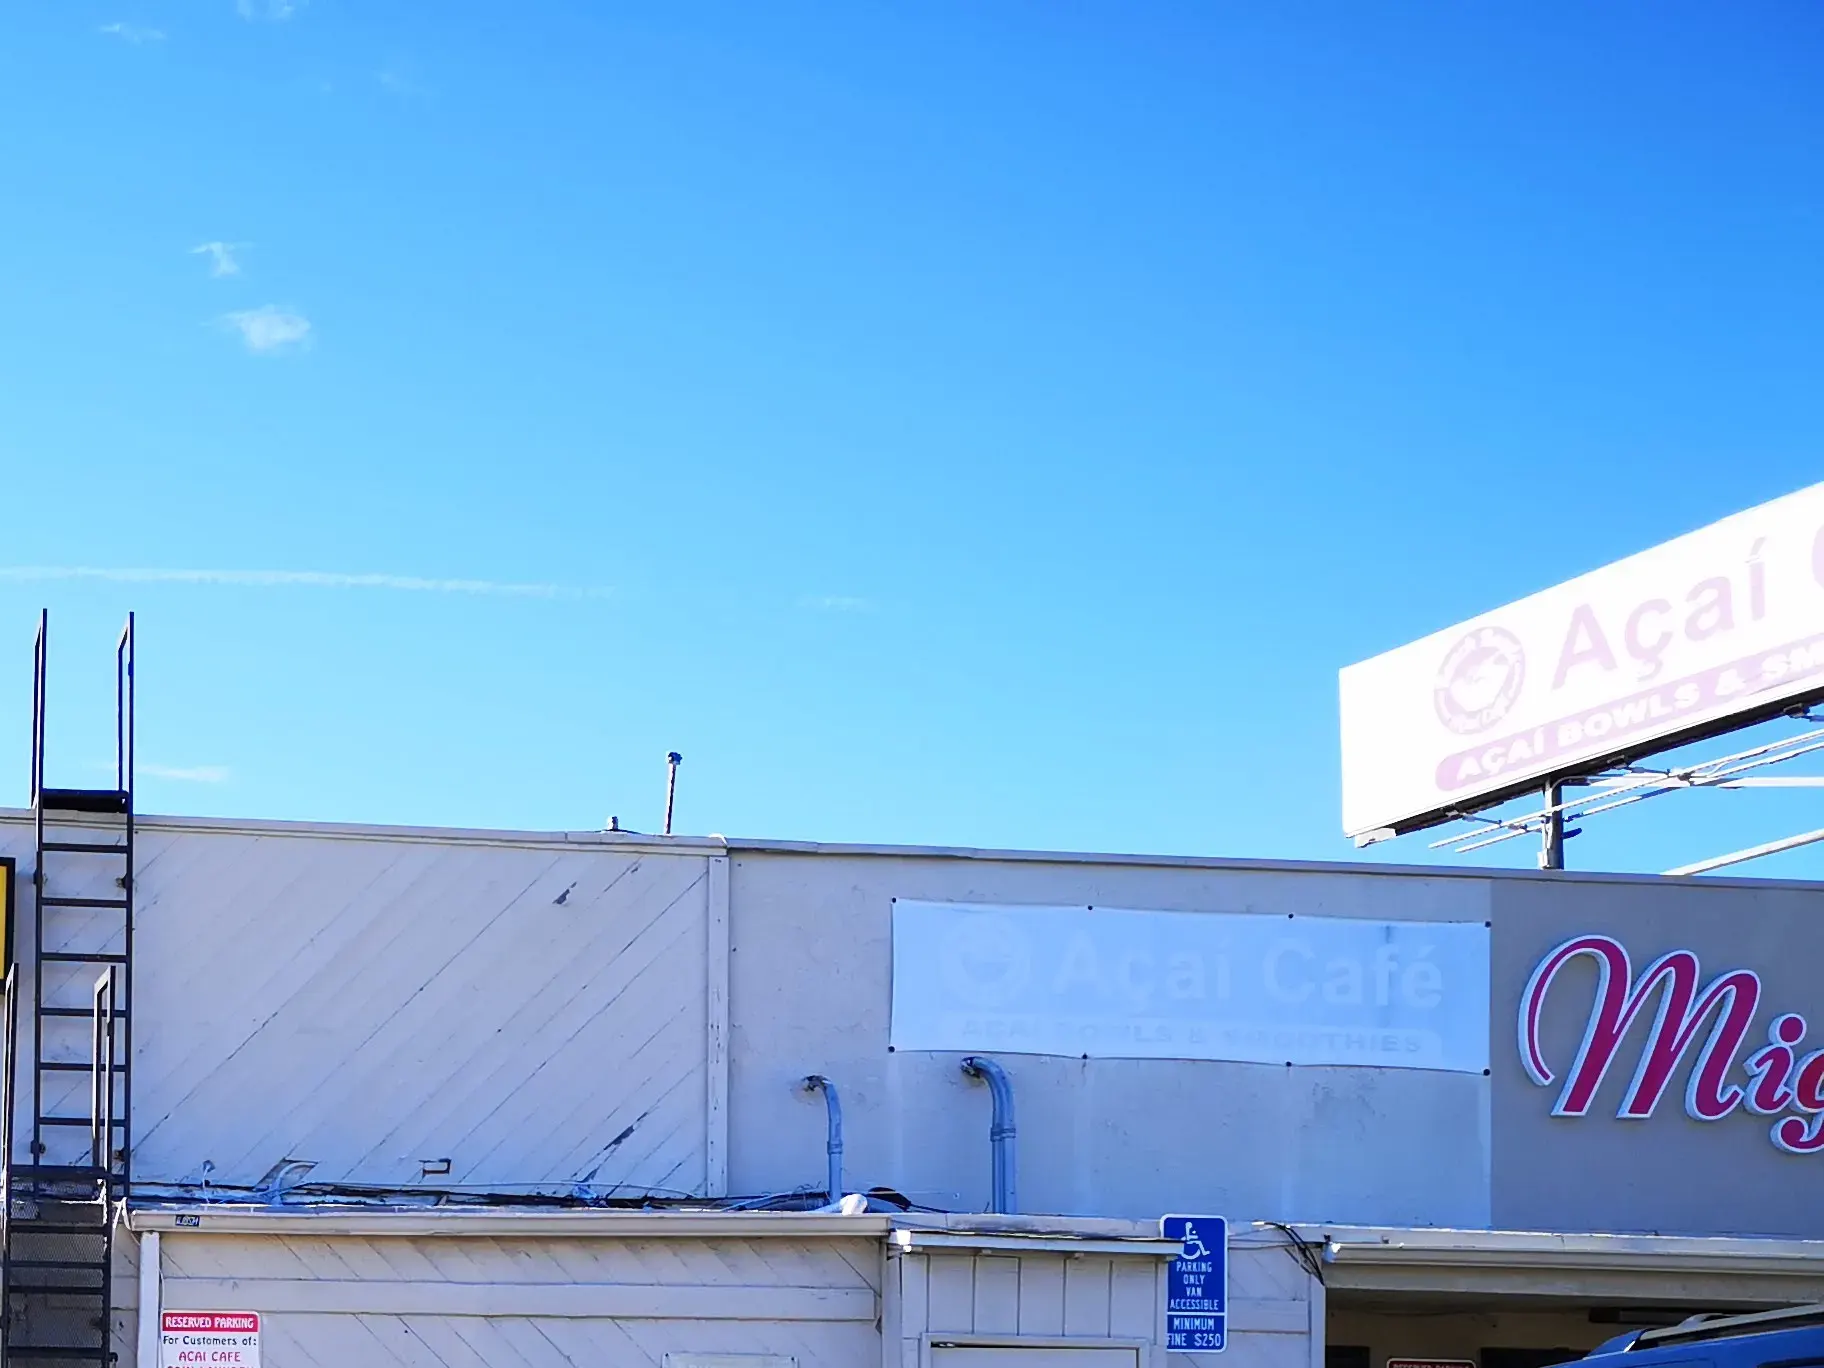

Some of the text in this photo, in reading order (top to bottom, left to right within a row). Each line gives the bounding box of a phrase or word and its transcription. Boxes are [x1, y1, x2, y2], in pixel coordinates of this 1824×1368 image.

[1552, 536, 1768, 692] Açaí
[1556, 683, 1702, 748] BOWLS
[1713, 669, 1747, 697] &
[1051, 930, 1234, 1012] Açaí
[1263, 936, 1444, 1010] Café
[1176, 1261, 1213, 1273] PARKING
[1183, 1274, 1206, 1285] ONLY
[1185, 1286, 1202, 1297] VAN
[1169, 1299, 1219, 1311] ACCESSIBLE
[165, 1316, 254, 1329] RESERVED PARKING
[1173, 1318, 1215, 1331] MINIMUM
[163, 1335, 257, 1346] For Customers of:
[1167, 1333, 1222, 1347] FINE $250
[178, 1351, 241, 1363] ACAI CAFE
